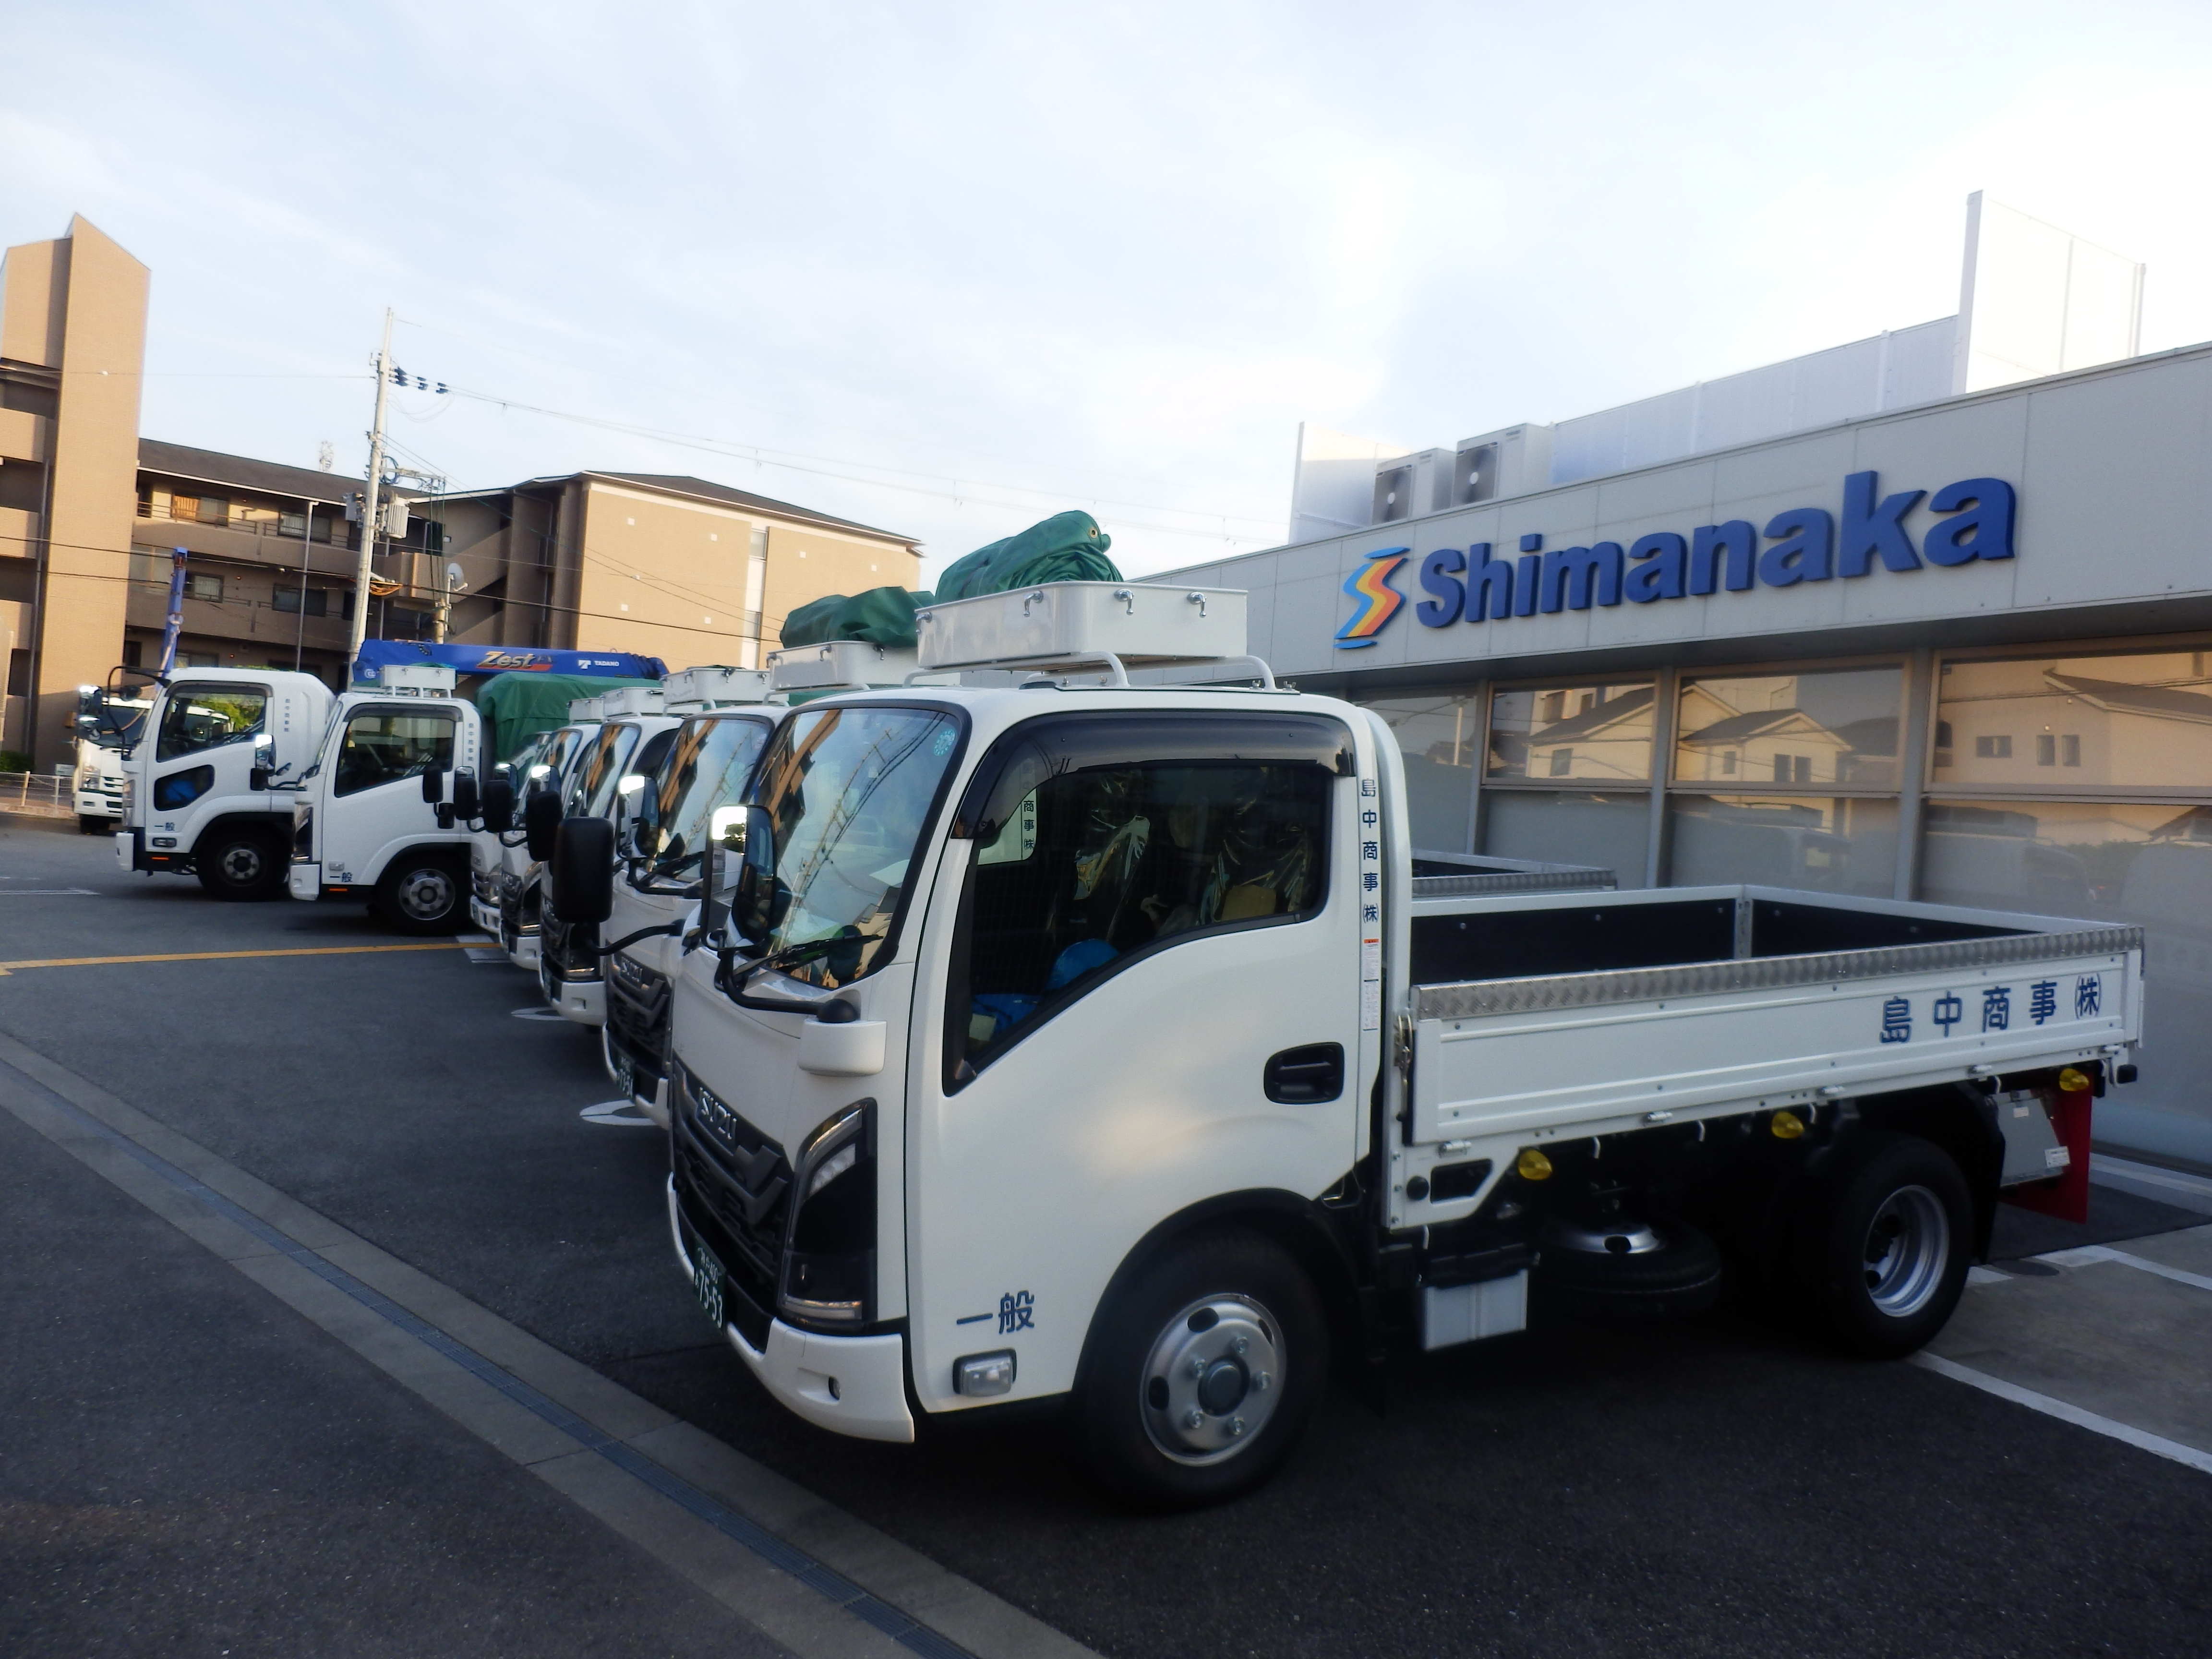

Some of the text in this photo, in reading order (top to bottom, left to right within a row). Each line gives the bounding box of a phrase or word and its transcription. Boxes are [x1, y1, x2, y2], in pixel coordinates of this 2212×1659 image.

[1416, 470, 2017, 629] Shimanaka
[477, 650, 536, 668] Zest
[329, 872, 352, 883] 一般
[699, 1086, 737, 1140] ISUZU
[956, 1290, 1034, 1334] 一般
